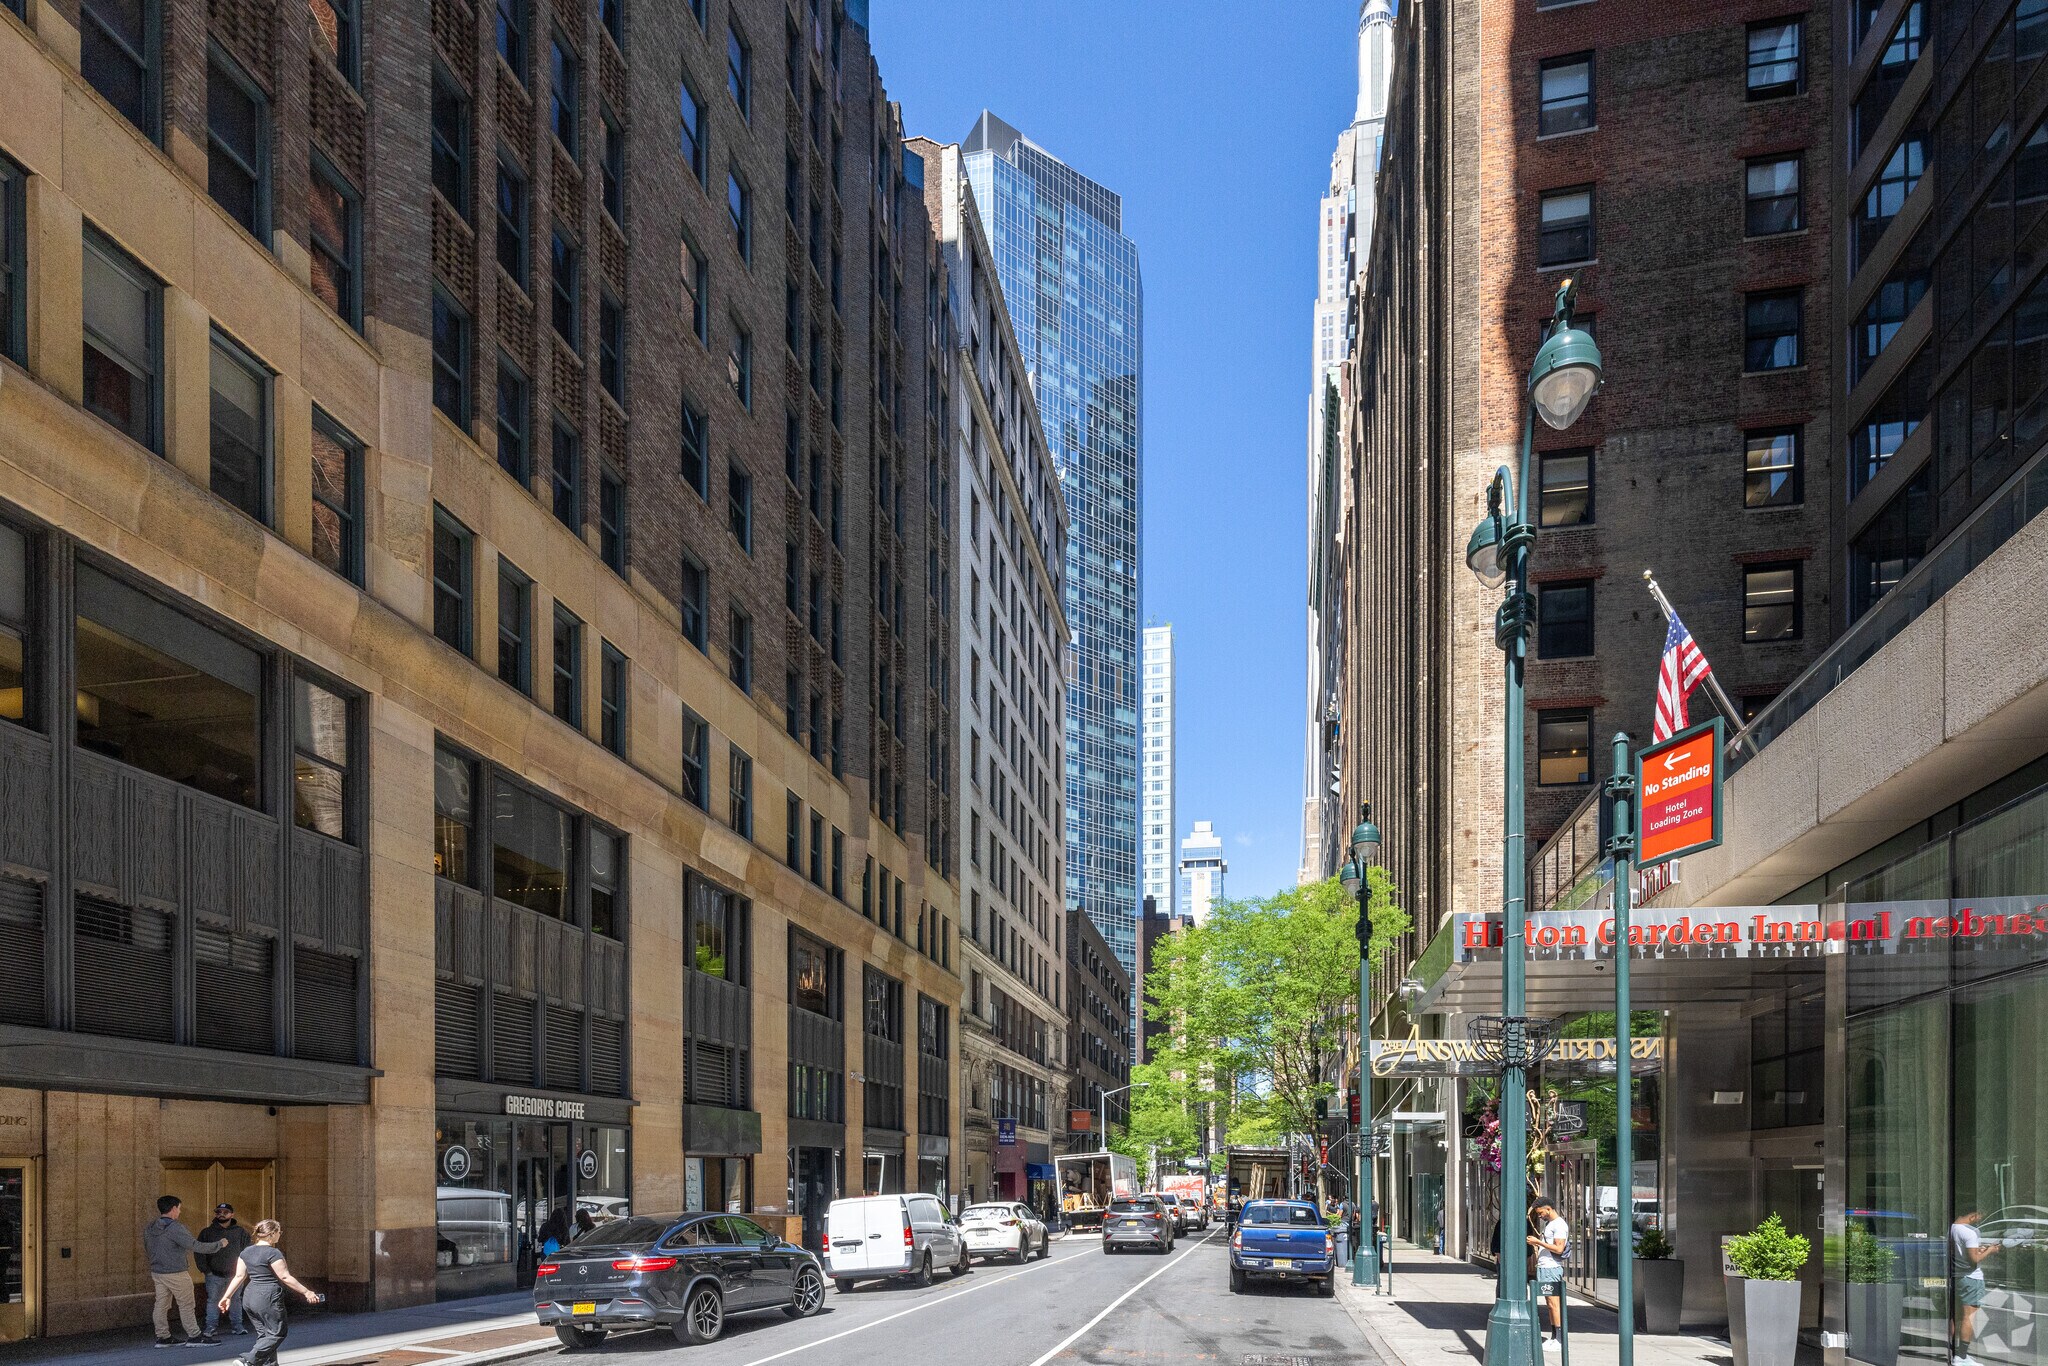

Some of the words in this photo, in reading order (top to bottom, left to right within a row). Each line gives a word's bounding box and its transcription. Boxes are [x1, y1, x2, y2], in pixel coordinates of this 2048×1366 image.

[1645, 783, 1660, 796] No
[1661, 763, 1710, 790] Standing
[1650, 814, 1681, 831] Loading
[1682, 806, 1703, 820] Zone
[1665, 798, 1687, 814] Hotel
[1463, 919, 1588, 948] Hiton
[1751, 914, 1826, 943] Inn
[506, 1095, 554, 1117] GREGORYS
[555, 1100, 585, 1120] COFFEE
